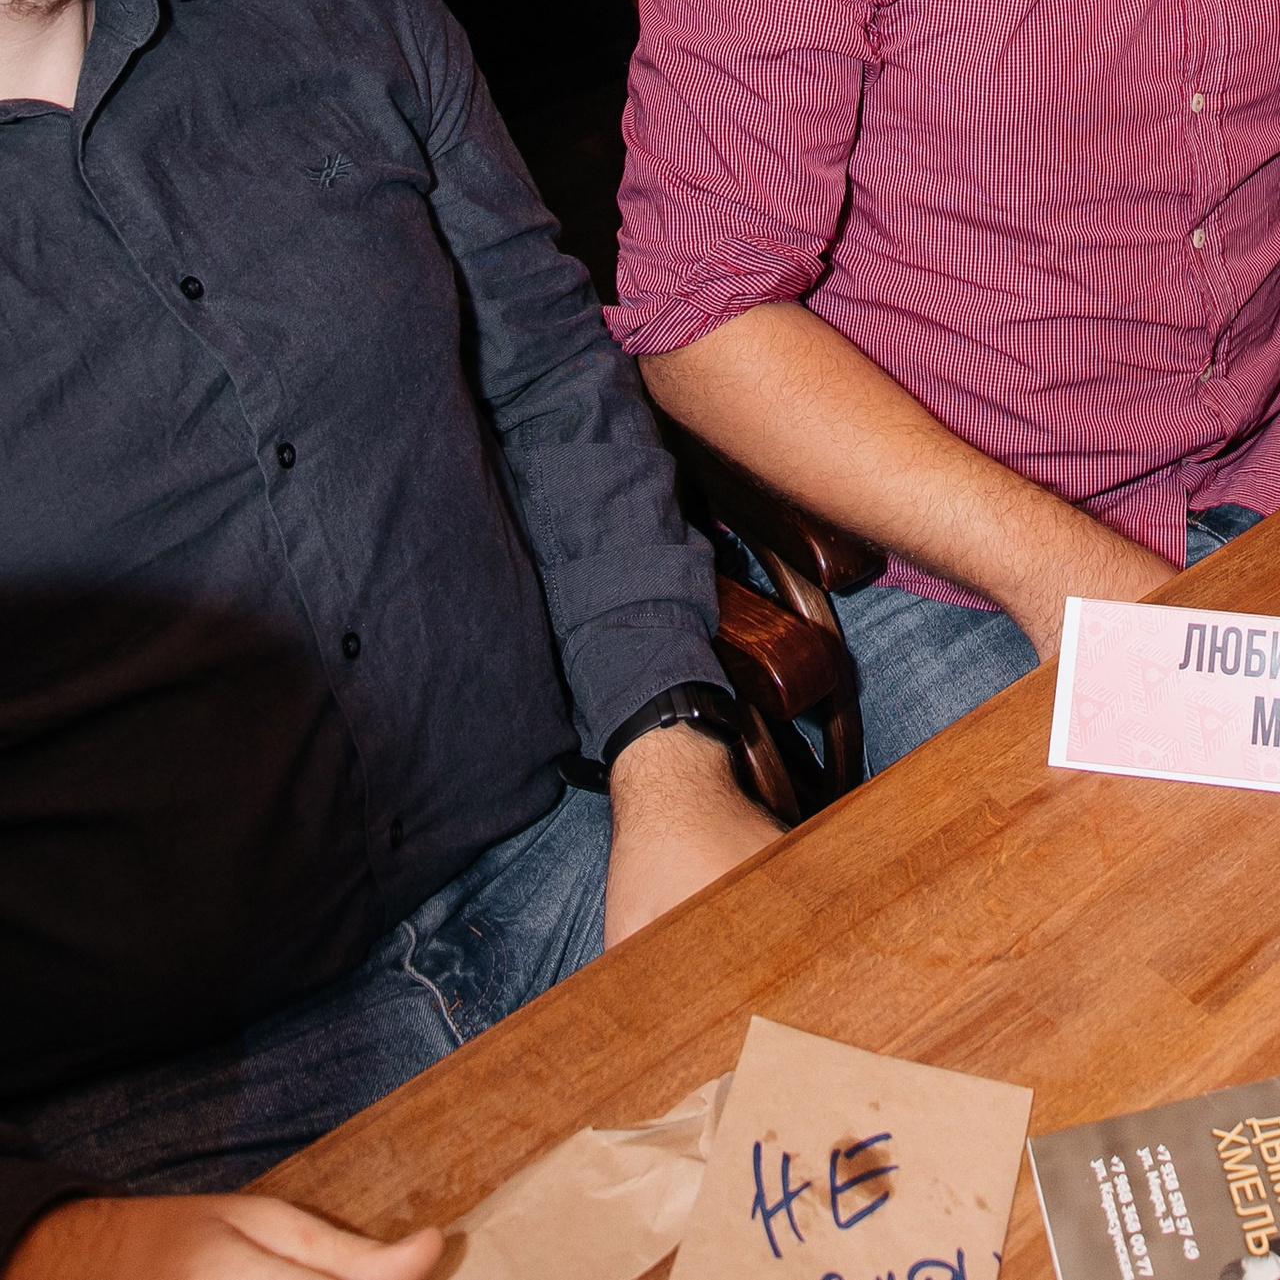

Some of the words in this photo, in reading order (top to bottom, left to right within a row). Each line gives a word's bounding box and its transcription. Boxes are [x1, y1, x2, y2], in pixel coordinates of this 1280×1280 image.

[1111, 1154, 1125, 1172] +7
[1157, 1144, 1171, 1160] +7
[750, 1131, 899, 1260] НЕ
[1211, 1122, 1278, 1256] ХМЕЛЬ
[1176, 1217, 1194, 1236] 57
[1130, 1233, 1147, 1256] 00
[1183, 1238, 1200, 1260] 49
[1136, 1255, 1154, 1277] 77
